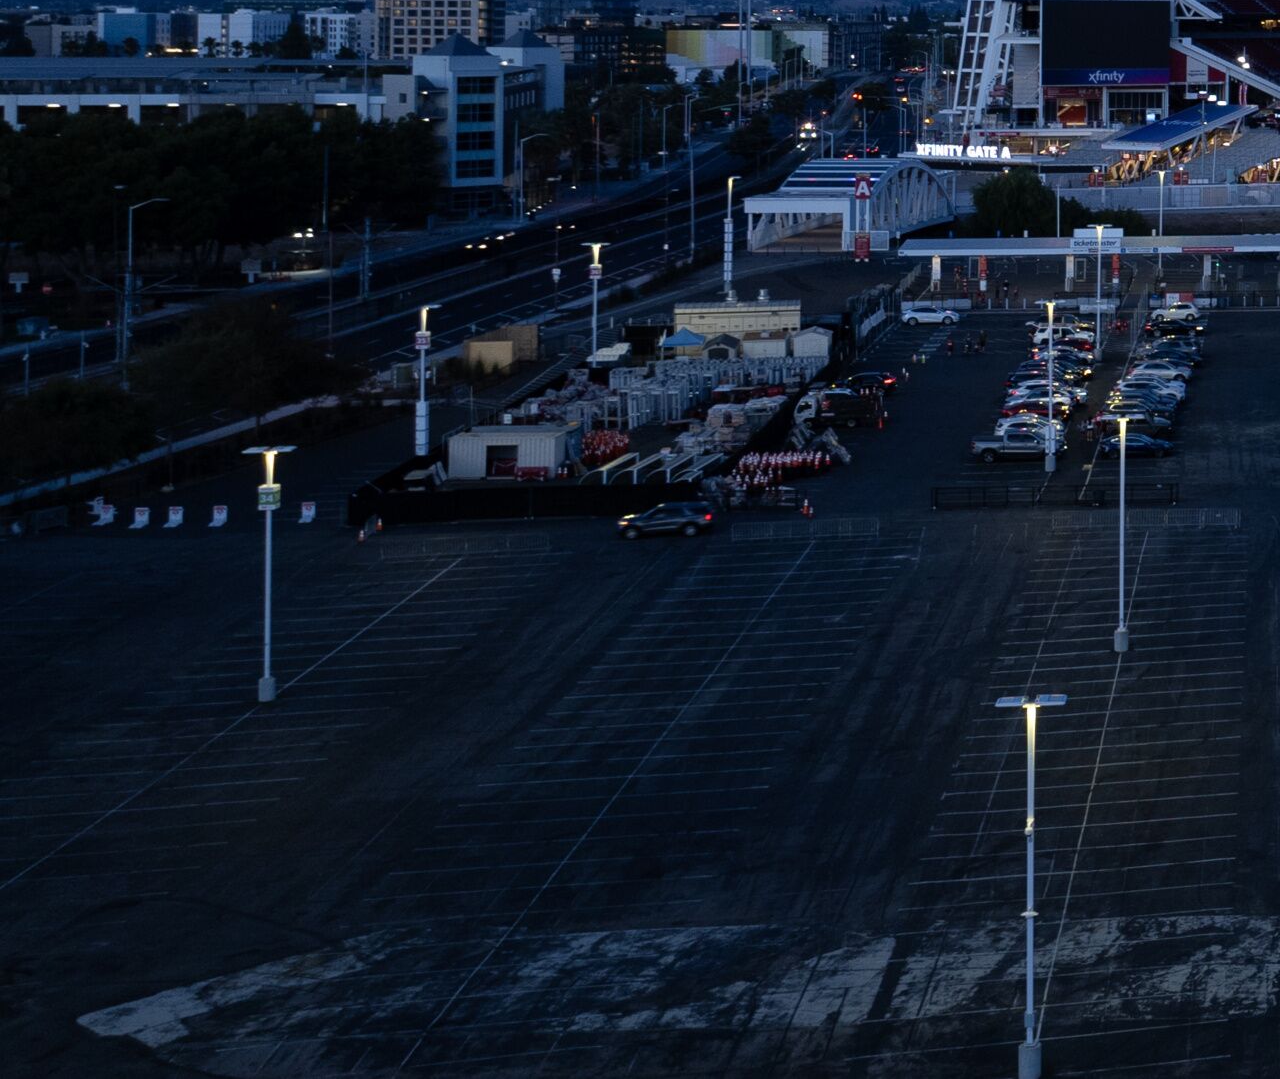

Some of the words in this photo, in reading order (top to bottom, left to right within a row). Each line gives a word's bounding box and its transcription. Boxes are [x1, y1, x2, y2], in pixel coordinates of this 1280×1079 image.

[1088, 70, 1125, 84] xfinity
[916, 143, 963, 157] XFINITY
[966, 145, 998, 158] GATE
[1001, 146, 1011, 159] A
[855, 180, 871, 196] A
[262, 494, 274, 502] 34
